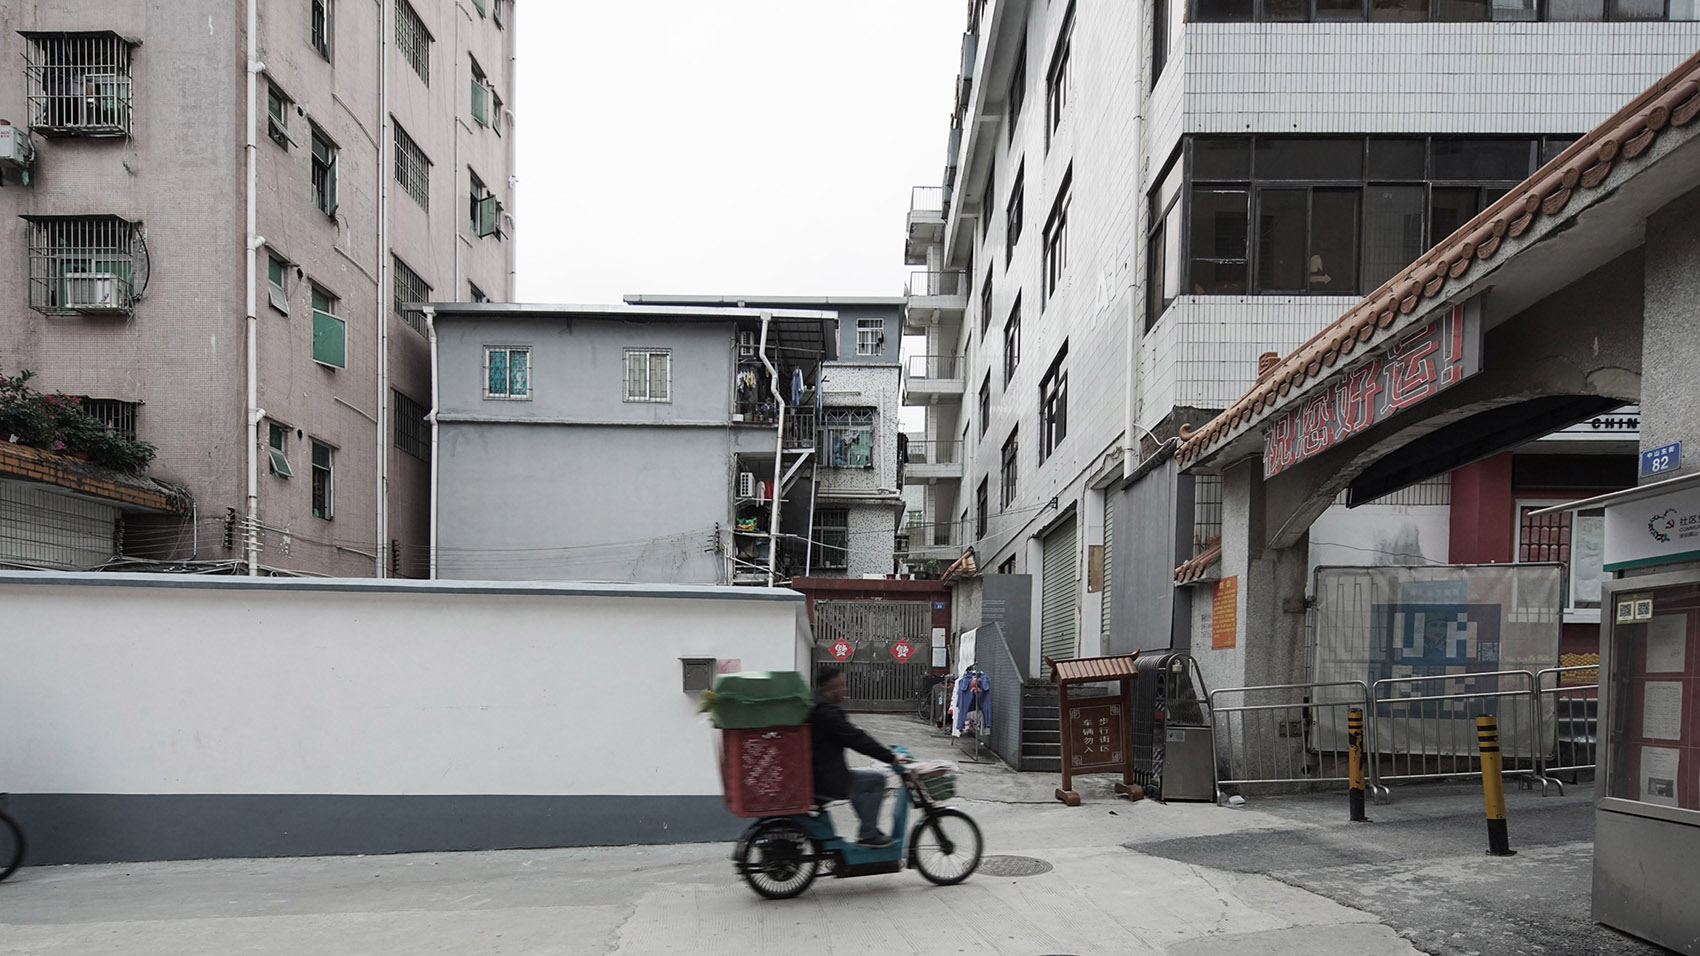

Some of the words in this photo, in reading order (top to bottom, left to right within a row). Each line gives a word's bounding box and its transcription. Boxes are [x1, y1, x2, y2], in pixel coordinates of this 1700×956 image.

[1652, 455, 1669, 472] 82
[1680, 514, 1700, 526] 社区
[1082, 719, 1094, 753] 车辆勿入
